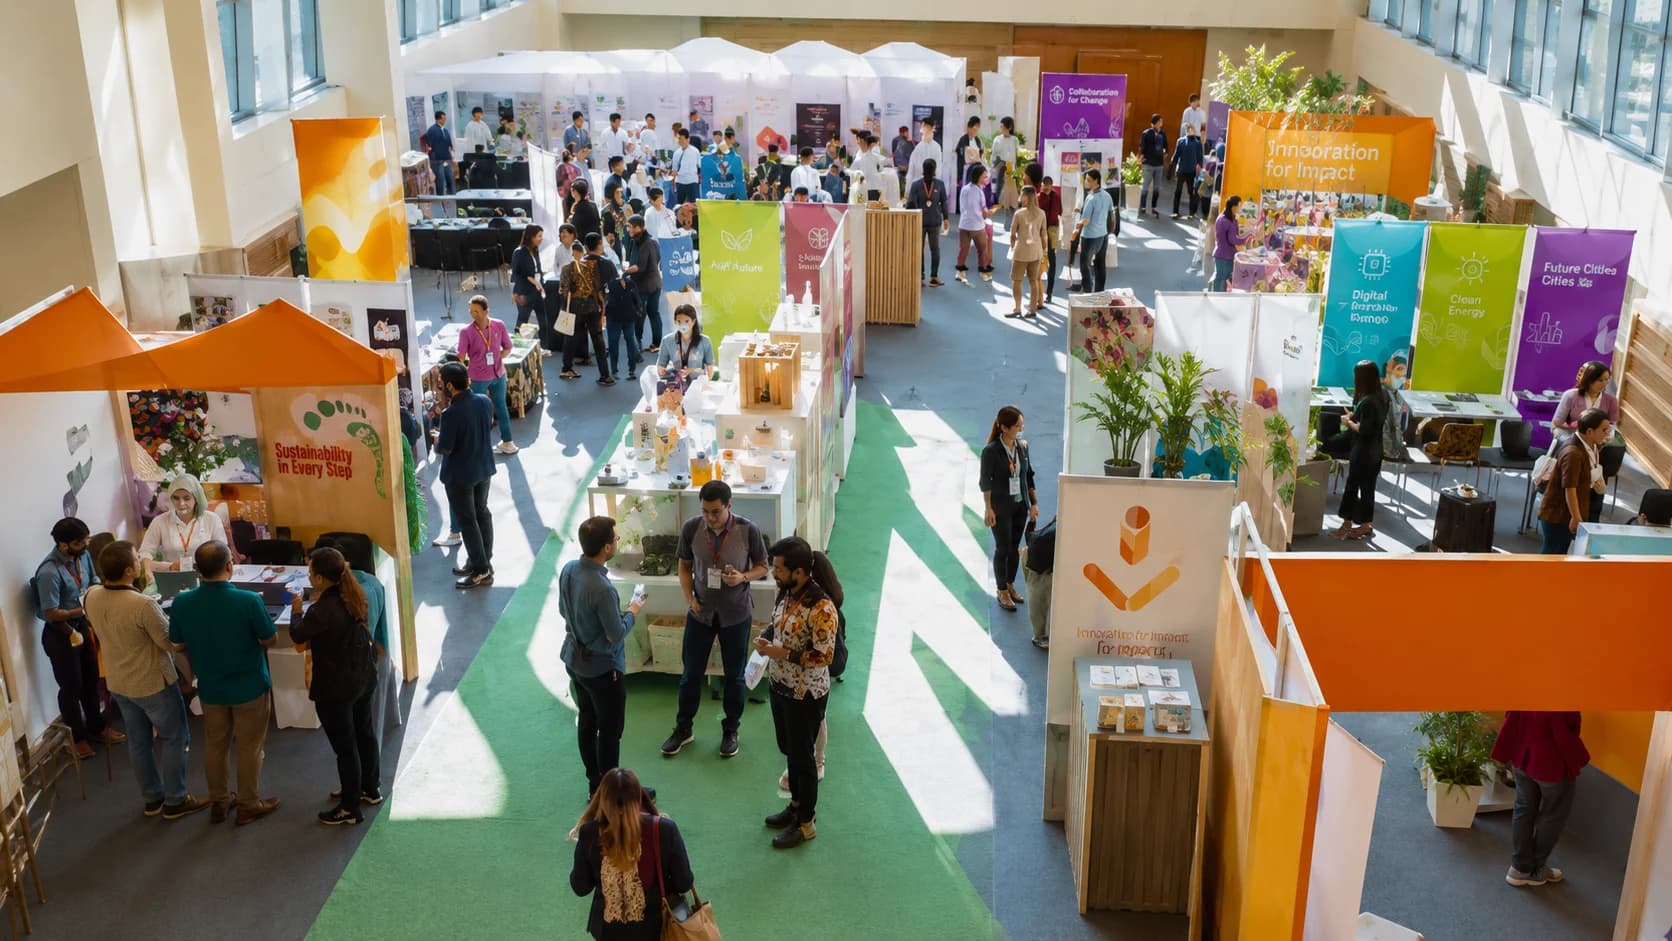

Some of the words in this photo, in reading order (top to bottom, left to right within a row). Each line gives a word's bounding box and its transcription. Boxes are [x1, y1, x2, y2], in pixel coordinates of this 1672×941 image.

[1068, 87, 1119, 97] Collaboration
[1068, 96, 1079, 104] for
[1080, 96, 1109, 106] Change
[1266, 160, 1293, 178] for
[1297, 160, 1356, 184] Impact
[1544, 262, 1581, 274] Future
[1542, 274, 1575, 287] Cities
[1352, 289, 1388, 302] Digital
[1448, 305, 1485, 319] Energy
[275, 442, 353, 465] Sustainability
[277, 459, 289, 474] in
[291, 460, 323, 479] Every
[326, 461, 353, 480] Step
